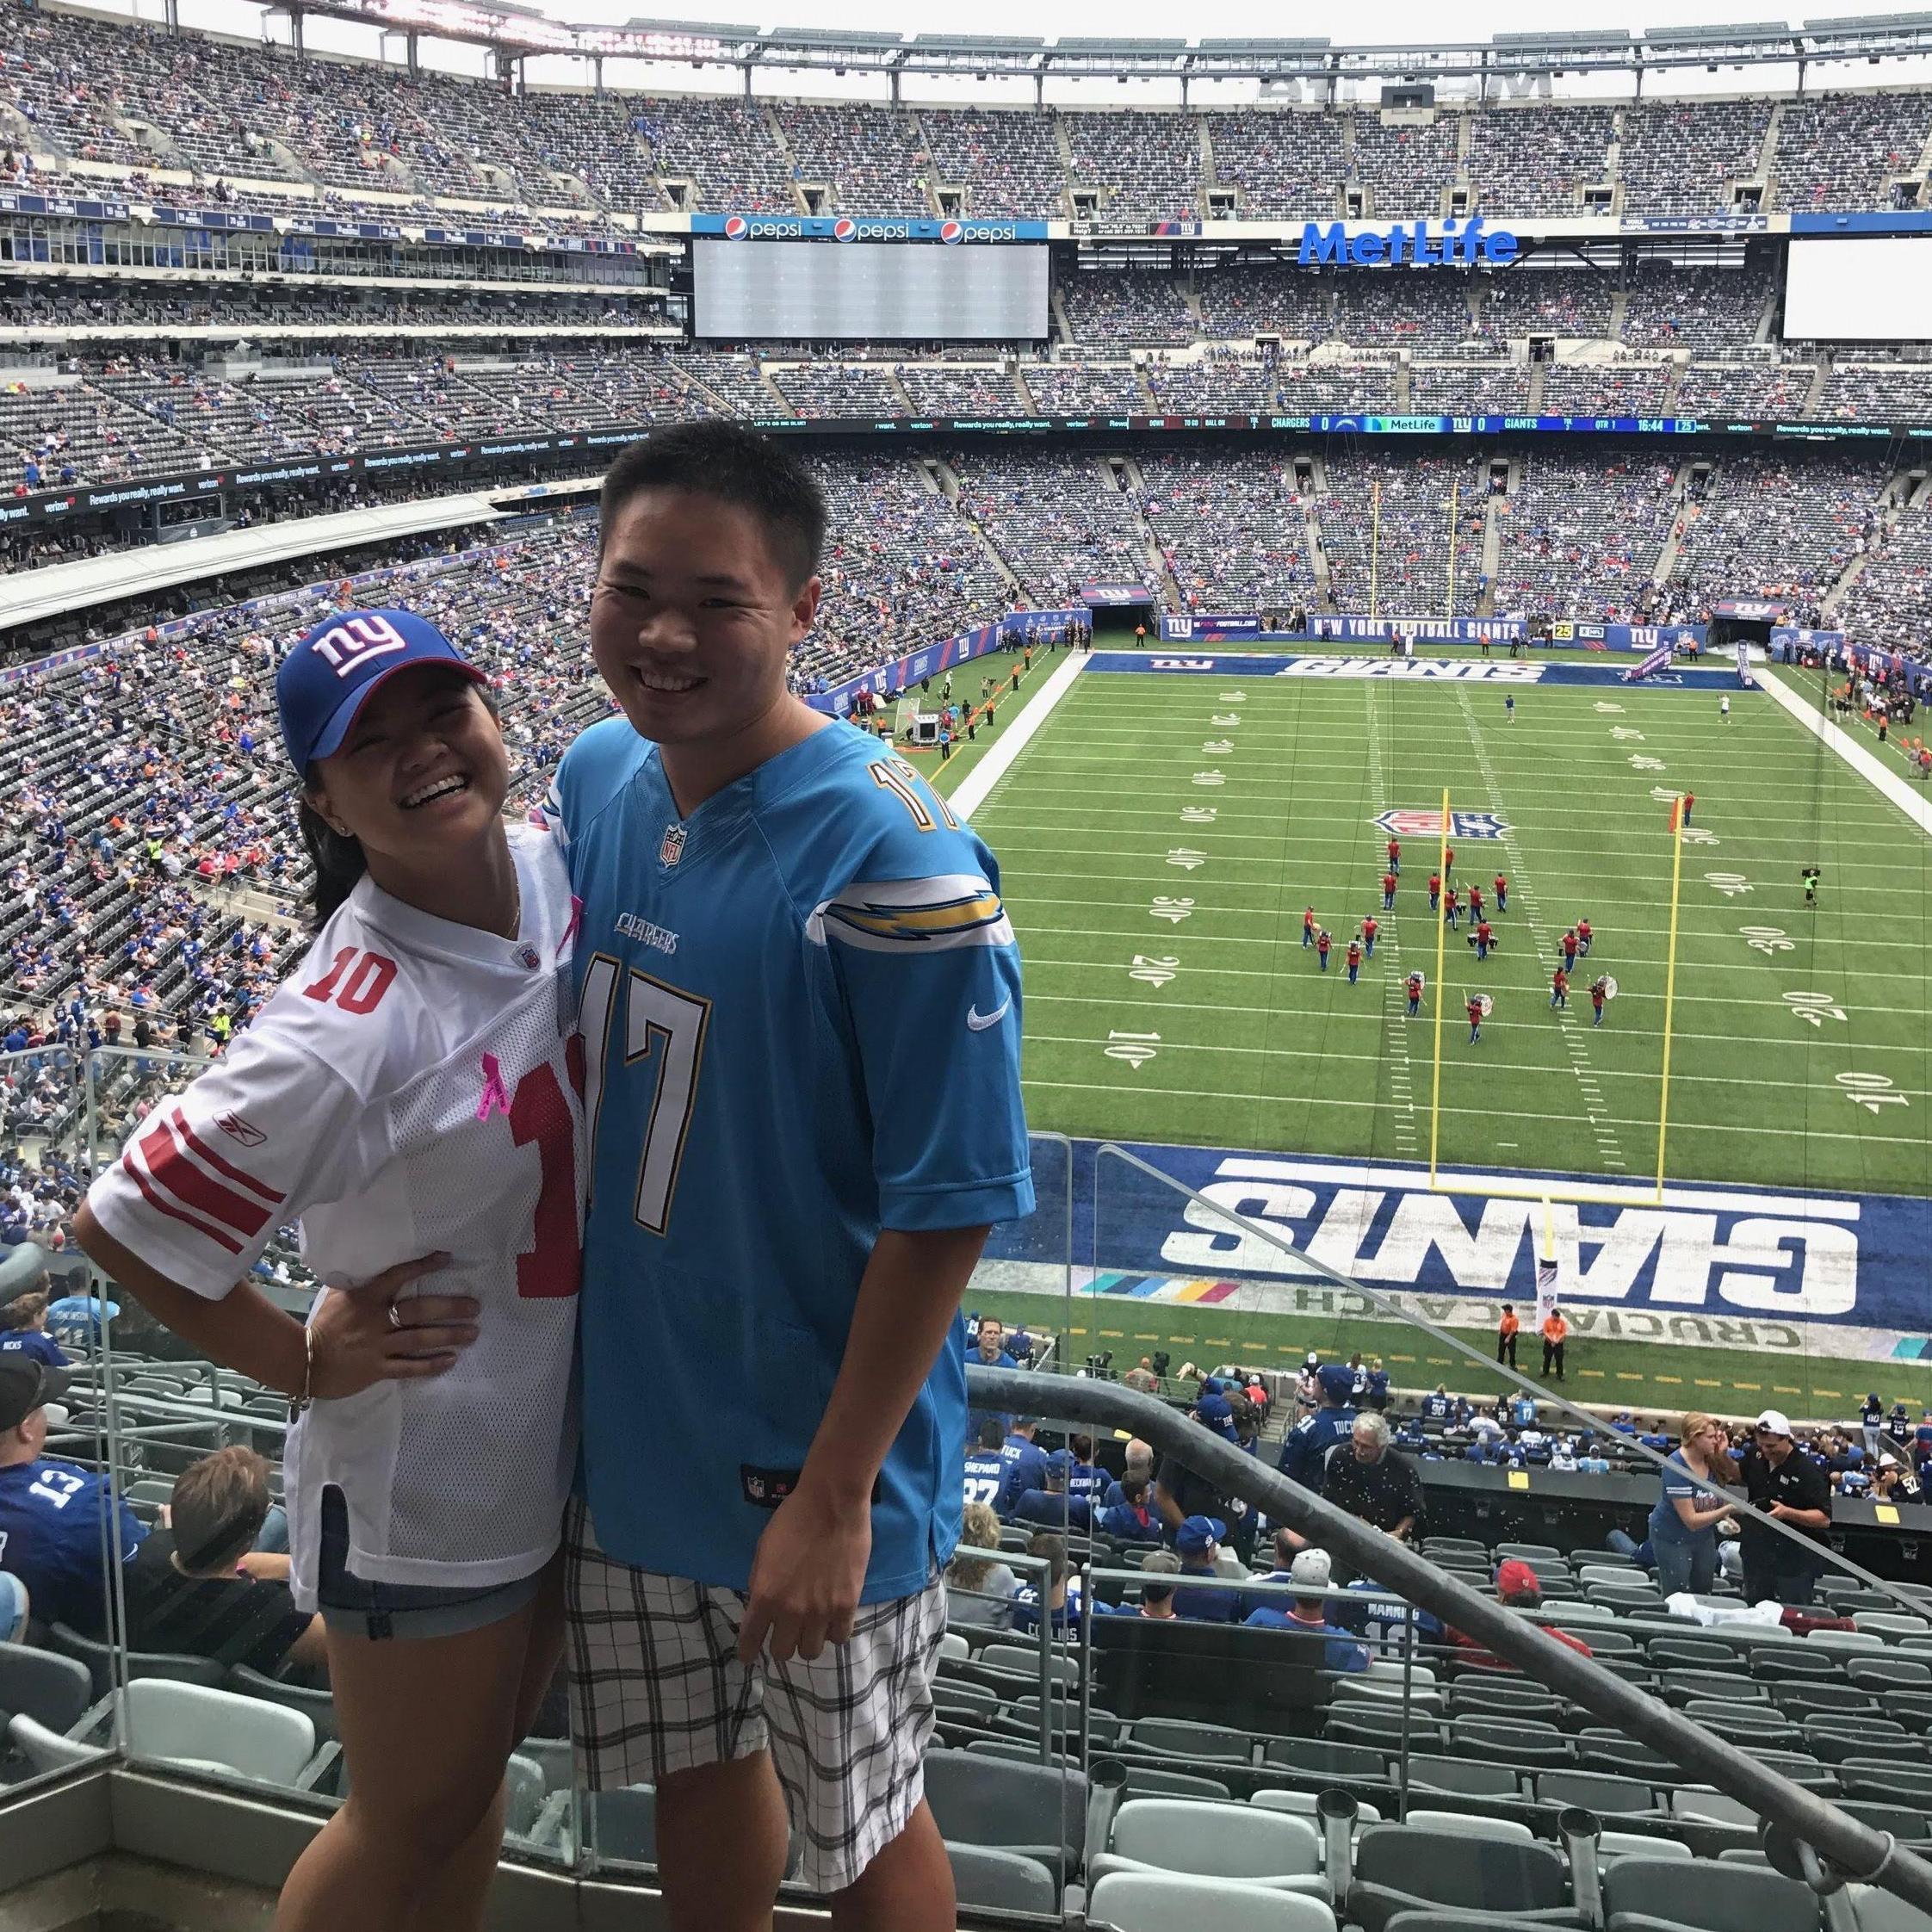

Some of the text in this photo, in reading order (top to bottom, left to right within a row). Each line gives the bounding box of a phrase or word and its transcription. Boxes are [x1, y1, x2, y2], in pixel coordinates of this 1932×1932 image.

[750, 220, 802, 240] pepsi
[858, 222, 909, 241] pepsi
[964, 225, 1016, 243] pepsi
[1297, 216, 1518, 265] MetLife
[995, 421, 1015, 430] really,
[1015, 421, 1033, 430] really
[1271, 418, 1310, 429] CHARGERS
[1322, 417, 1328, 430] 0
[1390, 419, 1436, 430] MetLife
[1452, 418, 1472, 432] ny
[1477, 418, 1486, 431] 0
[1505, 418, 1538, 429] GIANTS
[1595, 420, 1615, 430] QTR 1
[1638, 419, 1663, 431] 16:44
[1681, 422, 1692, 430] 25
[1825, 425, 1847, 435] really,
[1848, 426, 1869, 436] really
[90, 483, 186, 505] Rewards you really, really want.
[198, 480, 219, 490] verizon
[9, 505, 29, 519] want.
[45, 500, 69, 514] verizon
[1734, 604, 1772, 616] ny
[1167, 618, 1192, 638] ny
[1349, 619, 1385, 636] YORK
[1467, 622, 1520, 640] GIANTS
[1556, 625, 1571, 637] 25
[312, 615, 406, 678] ny
[1630, 628, 1657, 649] ny
[959, 638, 969, 659] ny
[1150, 659, 1213, 670] ny
[1286, 658, 1546, 683] GIANTS
[865, 757, 961, 835] 17
[1180, 806, 1217, 822] 50
[1165, 847, 1207, 866] 40
[1703, 872, 1755, 893] 40
[1149, 895, 1195, 918] 30
[614, 912, 680, 956] CHARGERS
[1738, 926, 1795, 951] 30
[1129, 953, 1180, 981] 20
[302, 945, 398, 1016] 10
[1782, 991, 1848, 1022] 20
[1104, 1029, 1161, 1061] 10
[579, 950, 712, 1238] 17
[1835, 1072, 1910, 1107] 10
[509, 1033, 587, 1298] 1
[1161, 1181, 1859, 1316] GIANTS
[1431, 1403, 1446, 1416] 90
[1523, 1407, 1533, 1421] 17
[1333, 1420, 1354, 1436] TUC
[964, 1462, 1000, 1475] SHEPARD
[29, 1469, 85, 1509] 13
[1902, 1475, 1921, 1495] 52
[1367, 1602, 1420, 1620] MANNIG
